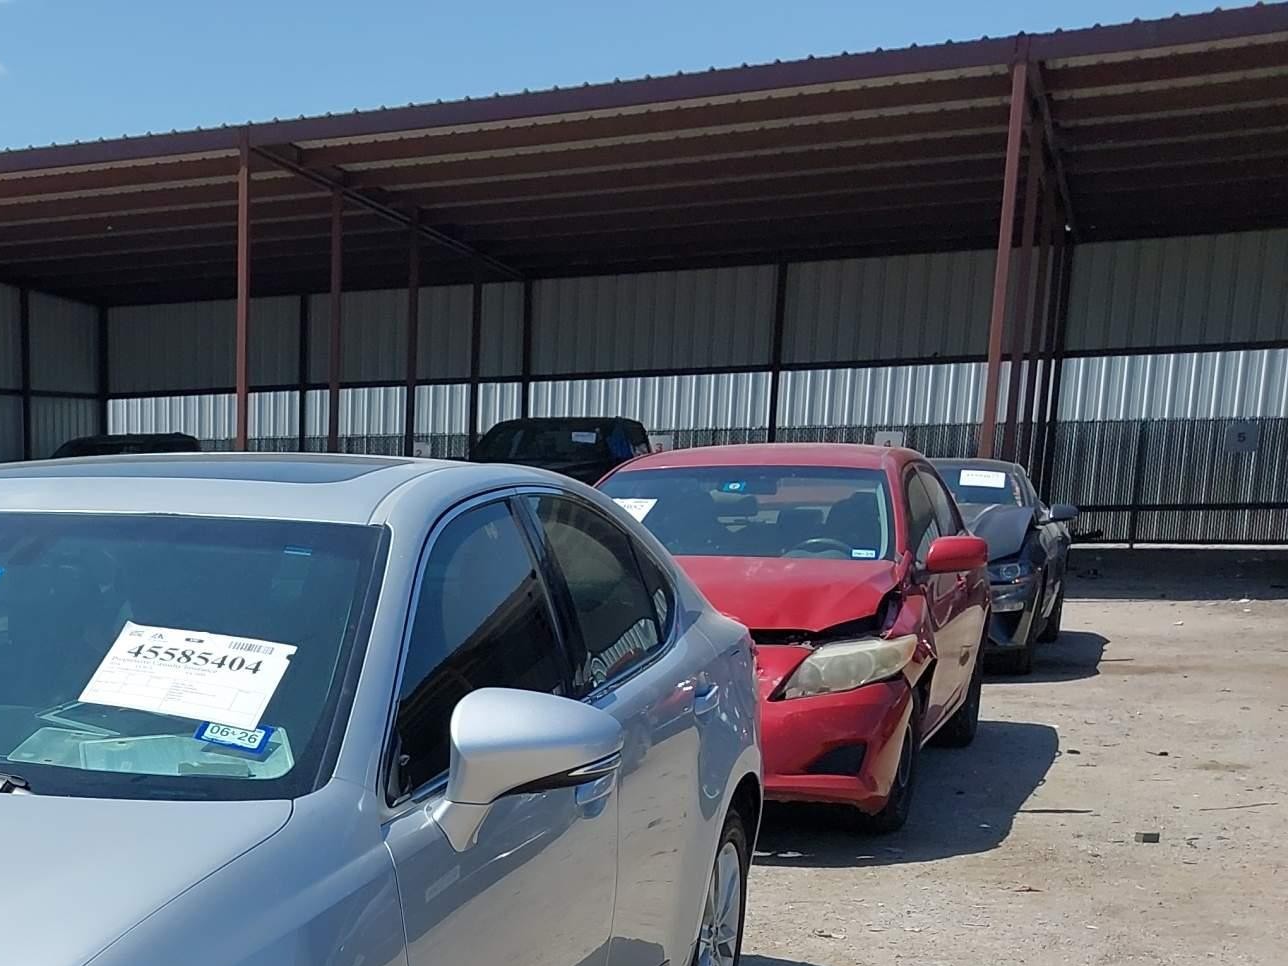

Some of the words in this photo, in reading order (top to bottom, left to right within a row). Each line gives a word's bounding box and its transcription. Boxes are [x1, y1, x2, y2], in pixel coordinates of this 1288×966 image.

[127, 643, 263, 675] 45585404
[210, 725, 231, 737] 06
[237, 731, 259, 744] 26
